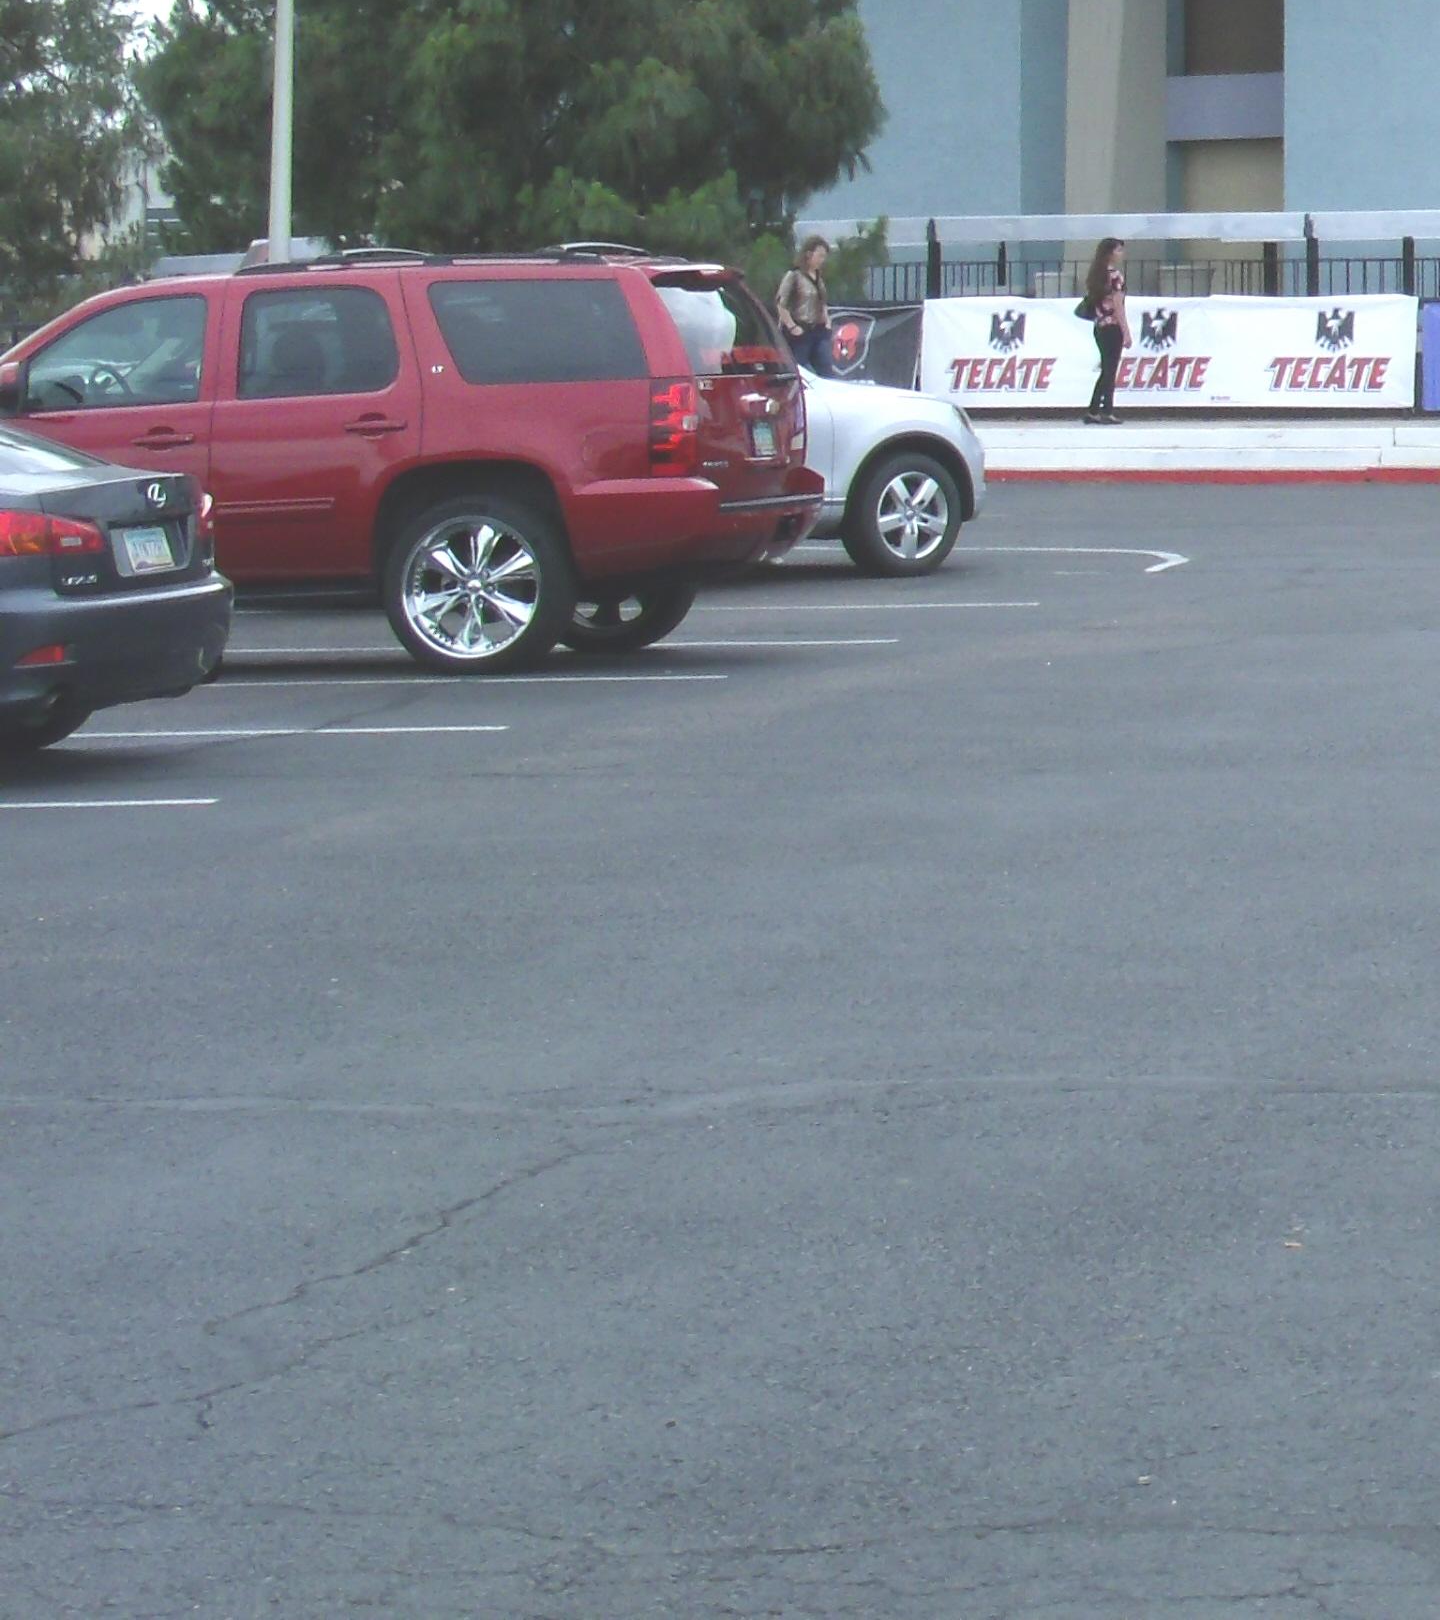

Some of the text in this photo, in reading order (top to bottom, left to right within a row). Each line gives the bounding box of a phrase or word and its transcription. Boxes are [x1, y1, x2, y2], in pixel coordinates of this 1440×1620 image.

[947, 356, 1057, 393] TECATE
[1114, 354, 1212, 392] ECATE
[1266, 355, 1392, 392] TECATE
